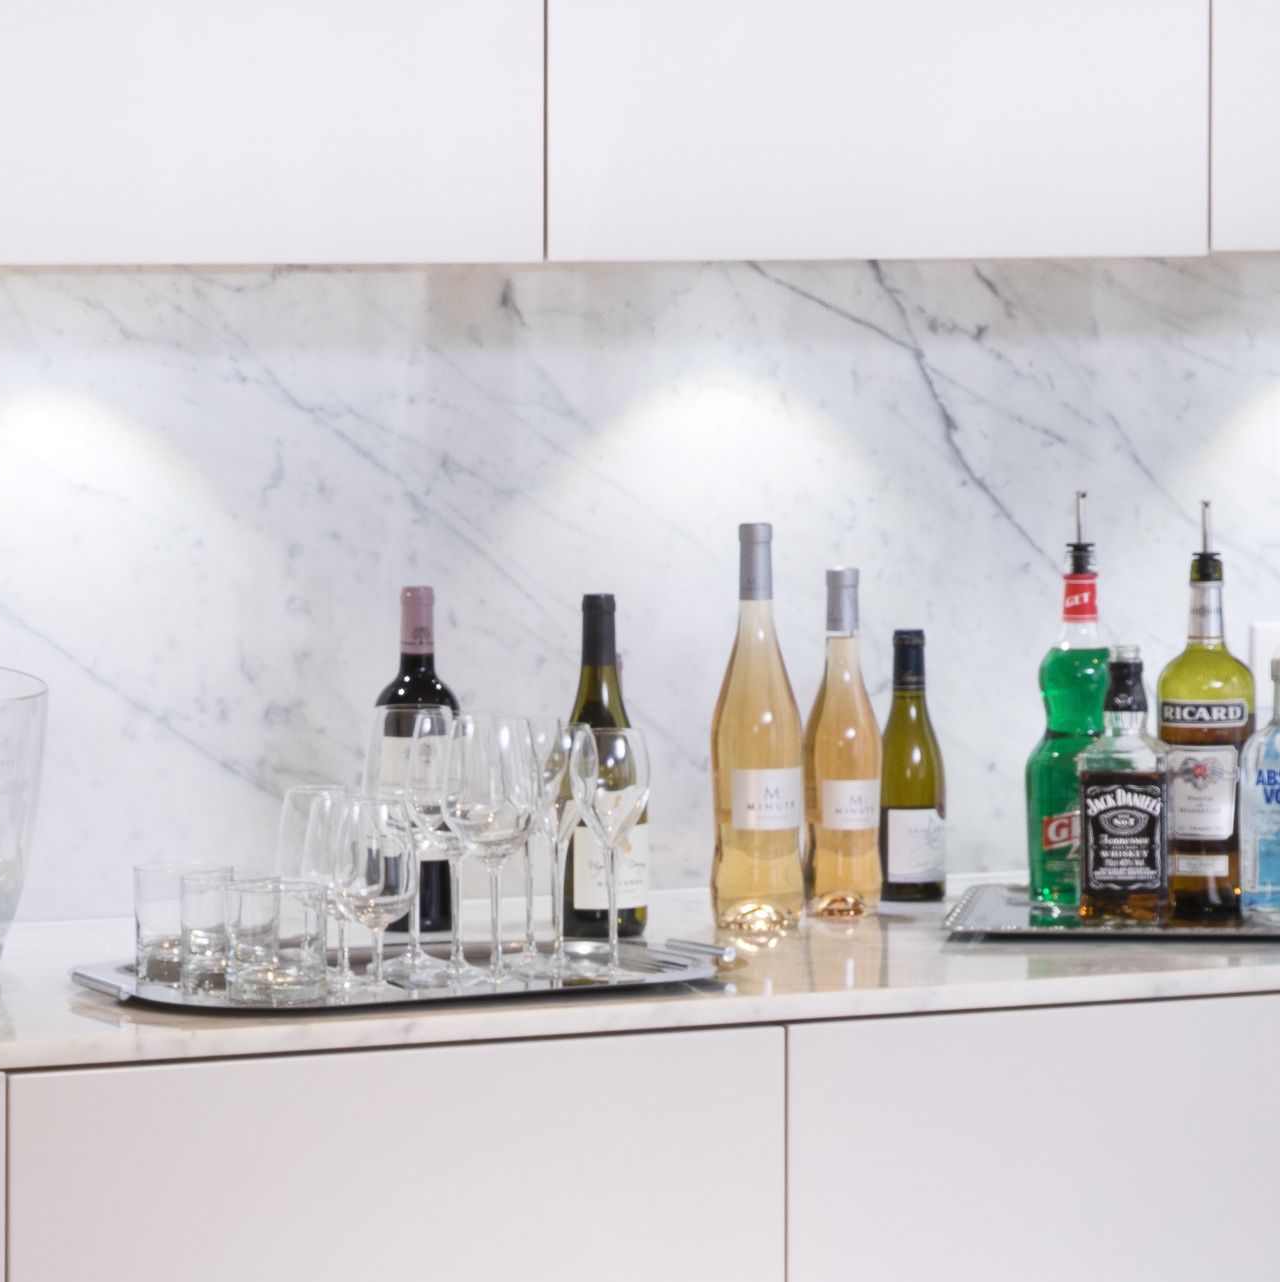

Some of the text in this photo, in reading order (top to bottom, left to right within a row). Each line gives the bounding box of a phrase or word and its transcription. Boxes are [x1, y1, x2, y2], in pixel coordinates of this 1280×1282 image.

[1064, 591, 1091, 608] GET
[1163, 705, 1241, 721] RICARD
[764, 786, 780, 800] M
[849, 795, 863, 805] M
[1086, 793, 1117, 816] JACK
[1101, 850, 1148, 859] WHISKEY
